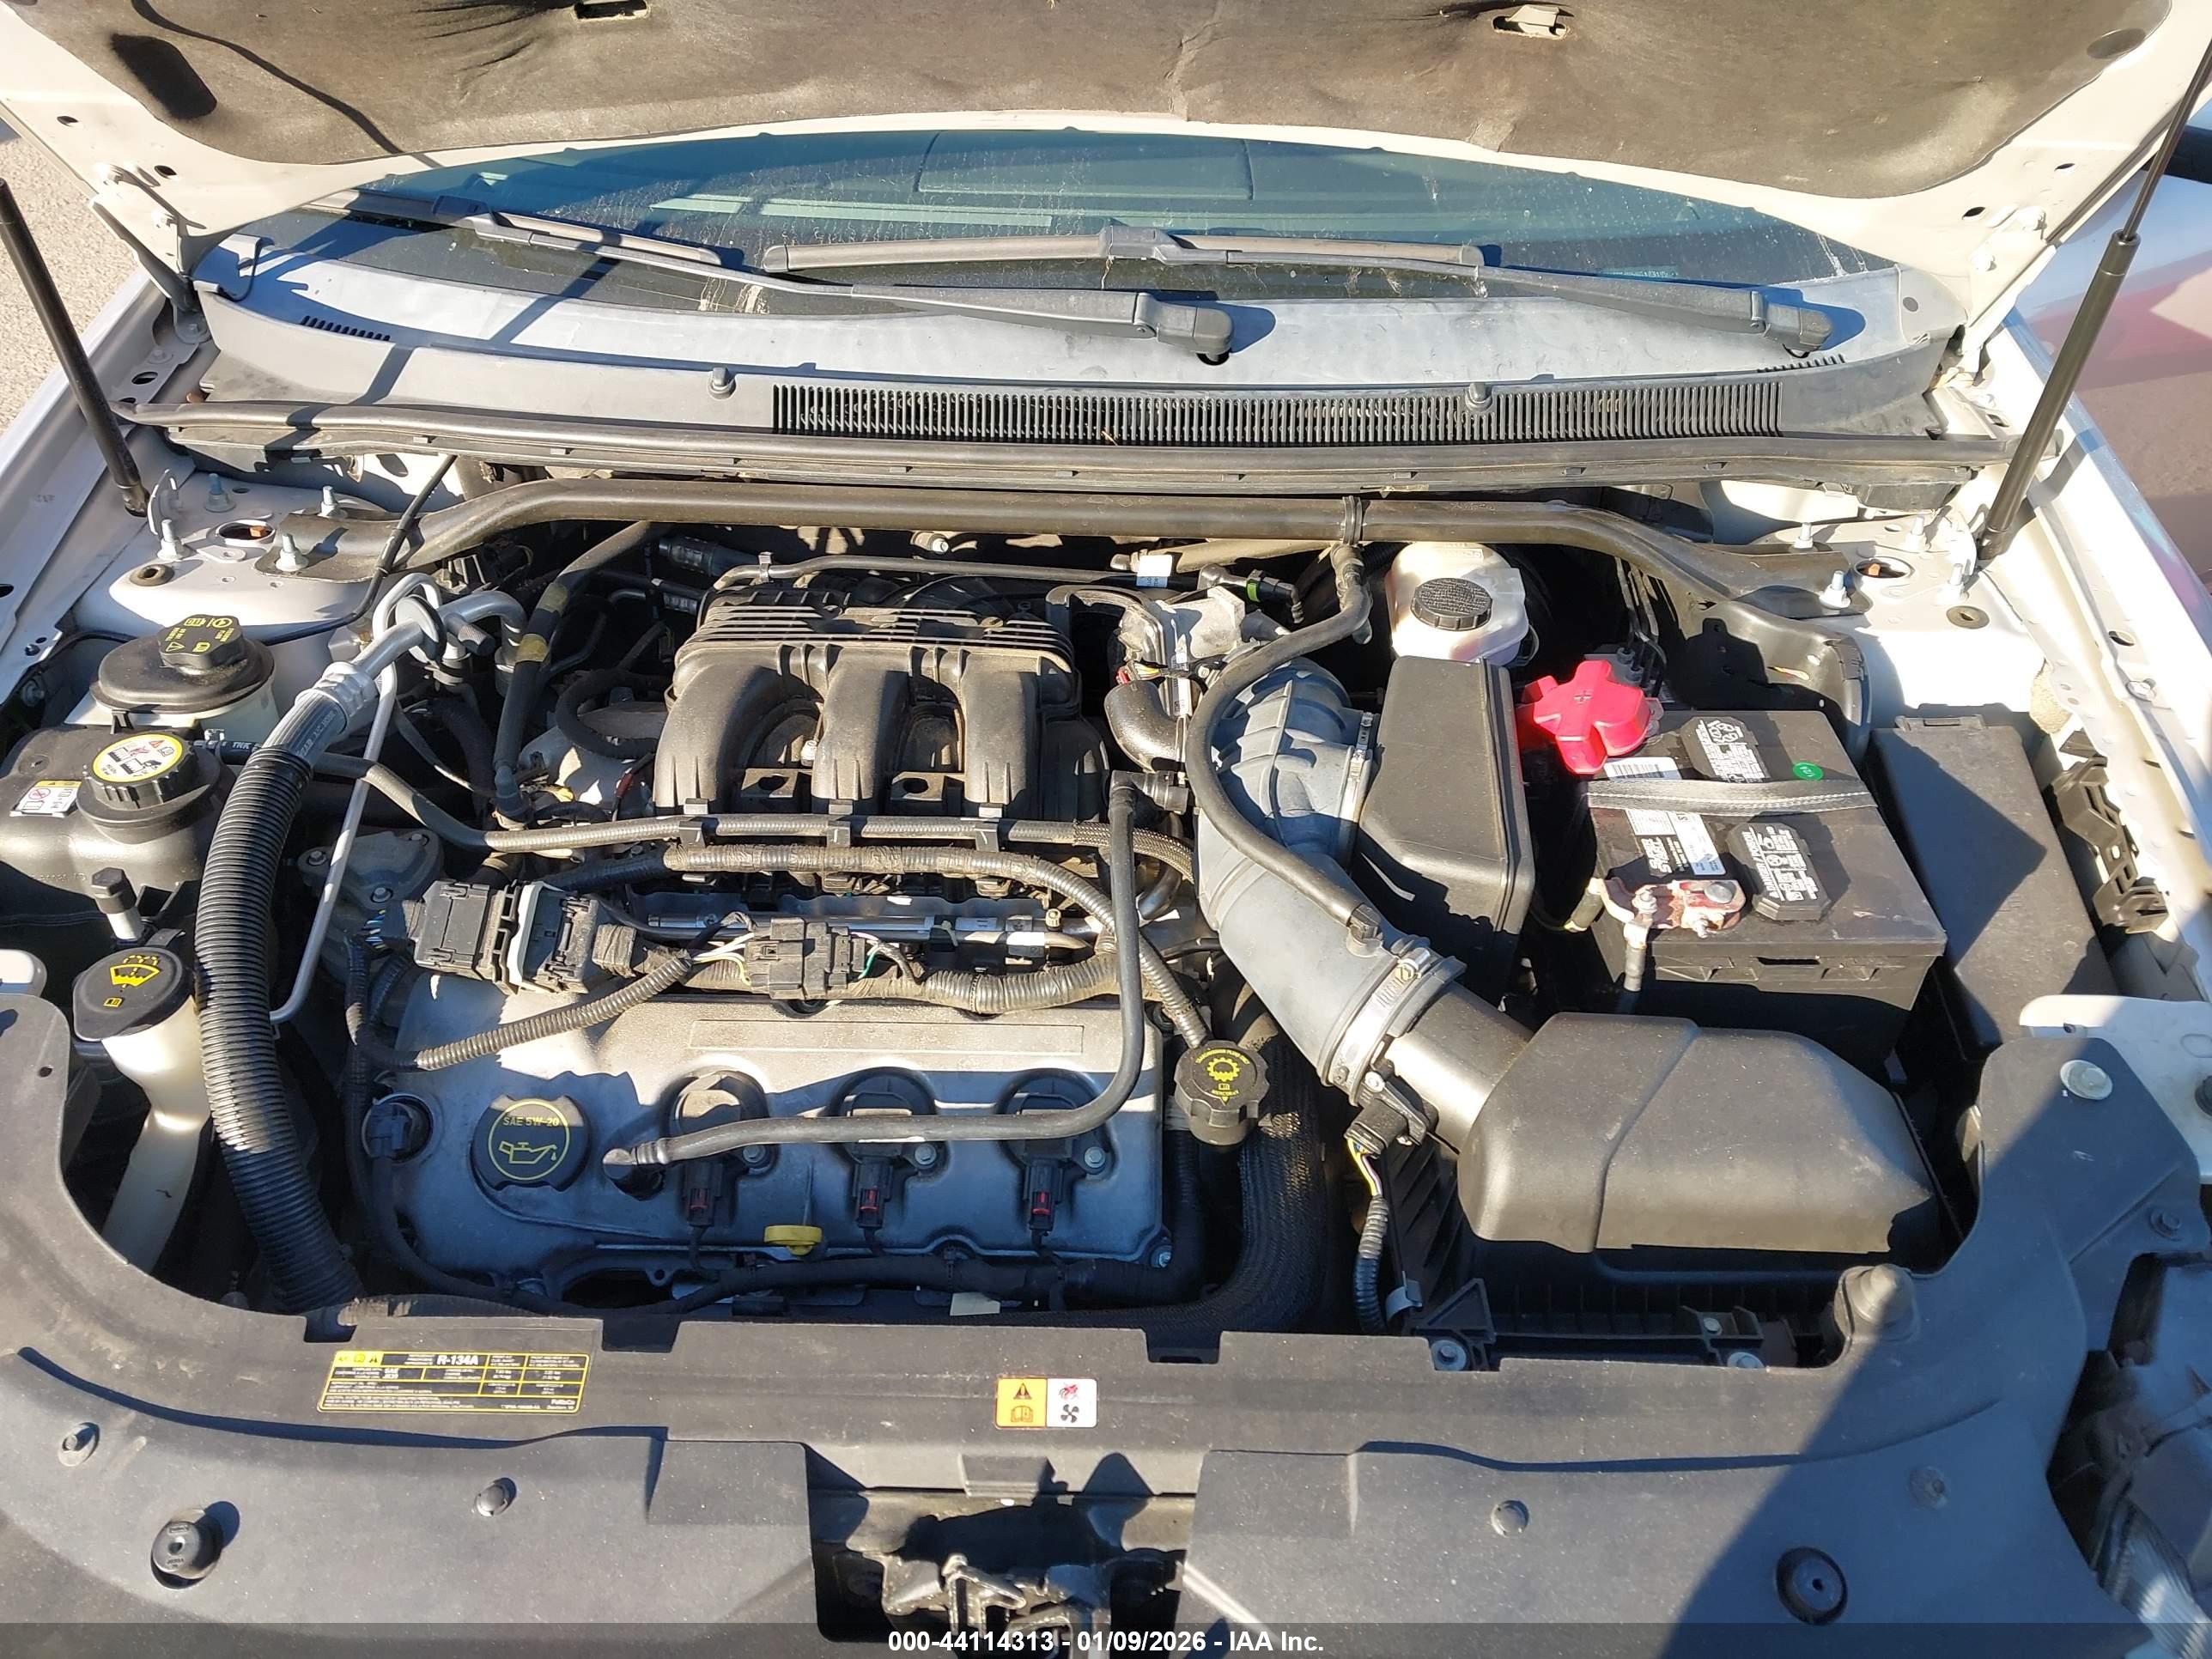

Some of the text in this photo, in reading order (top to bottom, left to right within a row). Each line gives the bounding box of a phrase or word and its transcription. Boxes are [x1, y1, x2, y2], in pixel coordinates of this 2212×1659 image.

[502, 1116, 560, 1127] SAE 5W-20
[436, 1354, 479, 1365] R-134A
